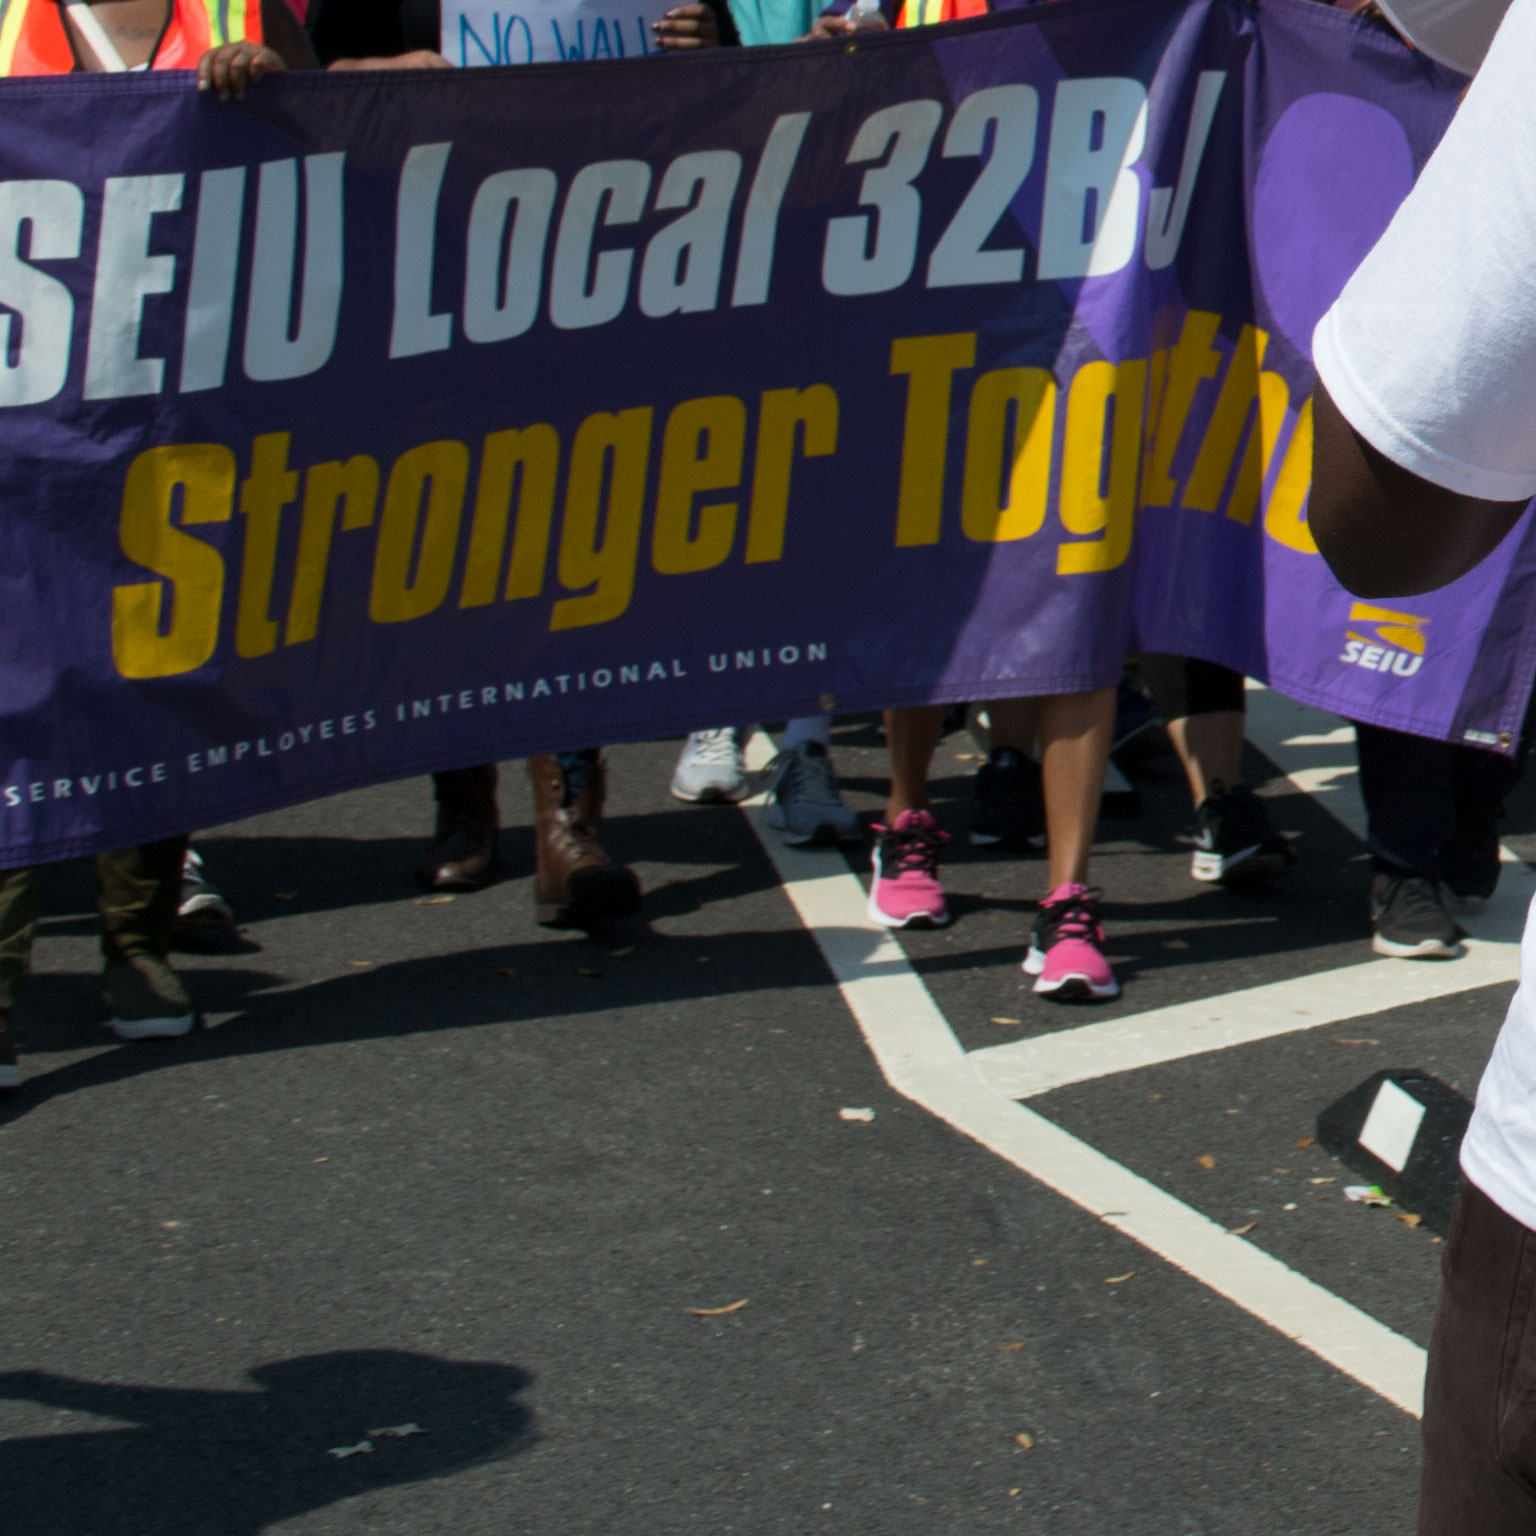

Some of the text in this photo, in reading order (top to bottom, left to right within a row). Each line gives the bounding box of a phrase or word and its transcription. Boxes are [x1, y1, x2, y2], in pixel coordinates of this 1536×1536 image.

[459, 12, 534, 67] NO
[0, 69, 1227, 407] SEIU Local 32BJ
[111, 384, 840, 680] Stronger
[3, 640, 830, 807] SERVICE EMPLOYEES INTERNATIONAL UNION
[1340, 640, 1424, 677] SEIU
